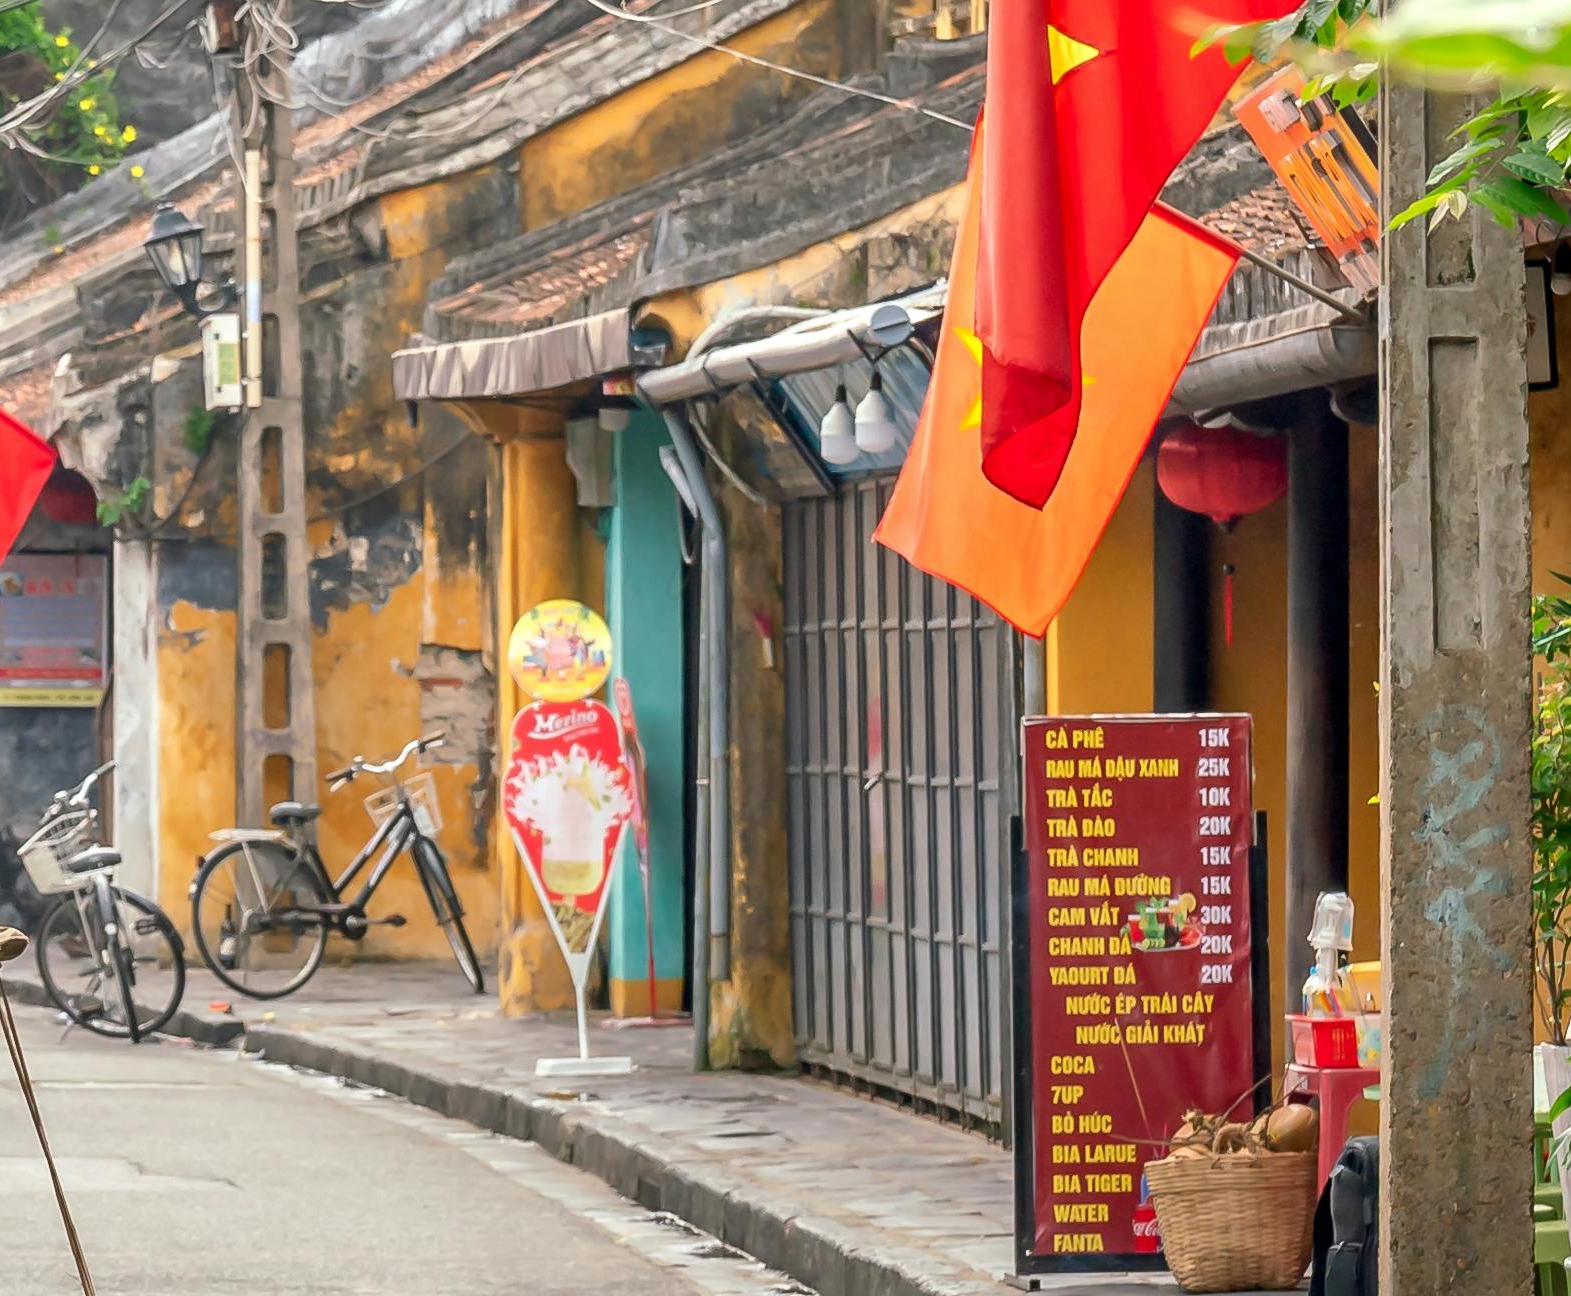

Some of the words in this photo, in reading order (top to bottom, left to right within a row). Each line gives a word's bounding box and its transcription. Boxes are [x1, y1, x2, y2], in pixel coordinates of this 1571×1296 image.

[533, 708, 598, 733] Merino
[1046, 727, 1068, 748] CÀ
[1073, 727, 1104, 748] PHÊ
[1199, 728, 1229, 747] 15K
[1046, 760, 1074, 778] RAU
[1079, 756, 1101, 777] MÁ
[1139, 759, 1178, 777] XANH
[1198, 758, 1229, 776] 25K
[1046, 786, 1077, 807] TRÀ
[1199, 787, 1230, 806] 10K
[1047, 815, 1078, 837] TRÀ
[1082, 815, 1115, 837] ĐÀO
[1200, 816, 1230, 835] 20K
[1047, 845, 1078, 866] TRÀ
[1083, 848, 1138, 867] CHANH
[1201, 847, 1230, 865] 15K
[1048, 878, 1079, 896] RAU
[1084, 874, 1110, 896] MÁ
[1201, 876, 1231, 894] 15K
[1049, 908, 1085, 926] CAM
[1201, 906, 1231, 925] 30K
[1049, 937, 1104, 955] CHANH
[1109, 932, 1132, 955] ĐÁ
[1201, 934, 1232, 954] 20K
[1050, 967, 1109, 985] YAOURT
[1114, 963, 1136, 984] ĐÁ
[1200, 964, 1232, 983] 20K
[1066, 993, 1110, 1014] NƯỚC
[1116, 992, 1136, 1014] ÉP
[1141, 992, 1177, 1014] TRÁI
[1182, 991, 1213, 1013] CÂY
[1076, 1021, 1121, 1045] NƯỚC
[1126, 1020, 1158, 1043] GIẢI
[1164, 1021, 1205, 1045] KHÁT
[1051, 1056, 1095, 1074] COCA
[1051, 1086, 1083, 1104] 7UP
[1052, 1111, 1074, 1133] BÒ
[1079, 1112, 1112, 1133] HÚC
[1053, 1145, 1080, 1163] BIA
[1085, 1145, 1136, 1163] LARUE
[1053, 1175, 1081, 1193] BIA
[1085, 1174, 1132, 1192] TIGER
[1054, 1204, 1108, 1223] WATER
[1054, 1234, 1103, 1252] FANTA
